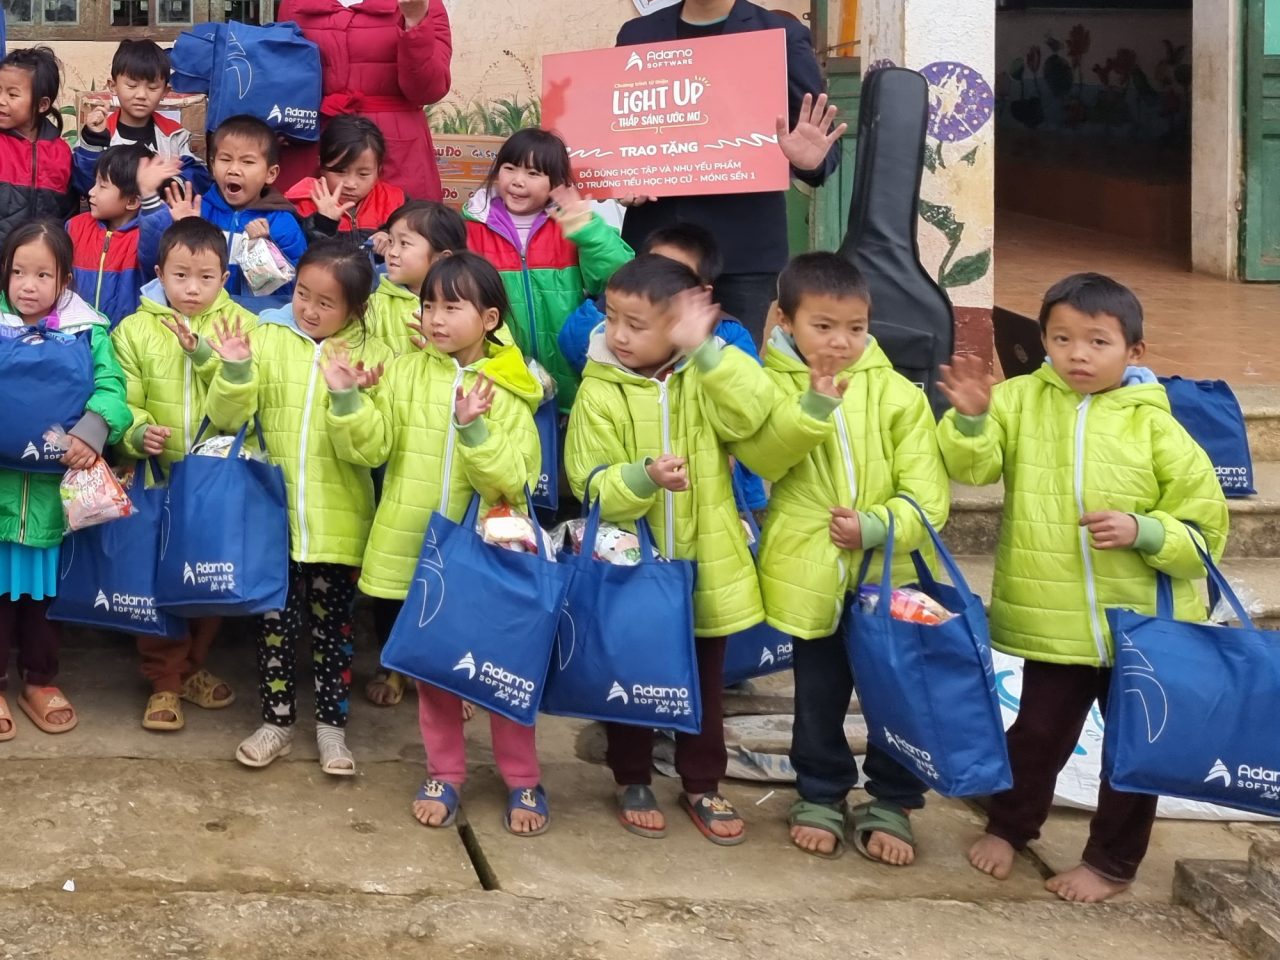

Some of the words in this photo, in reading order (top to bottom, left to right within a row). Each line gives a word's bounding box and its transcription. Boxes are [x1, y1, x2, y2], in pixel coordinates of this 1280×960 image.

[646, 48, 693, 61] Adamo
[647, 58, 693, 68] SOFTWARE
[673, 78, 704, 106] UP
[284, 106, 318, 118] Adamo
[620, 144, 657, 158] TRAO
[660, 140, 698, 157] TẶNG
[620, 168, 638, 176] HỌC
[750, 172, 755, 180] 1
[1214, 466, 1247, 475] damo
[196, 562, 234, 574] Adamo
[197, 574, 234, 584] SOFTWARE
[113, 606, 157, 616] SOFTWARE
[482, 662, 535, 692] Adamo
[478, 674, 531, 700] SOFTWARE
[632, 684, 688, 698] Adamo
[634, 697, 689, 708] SOFTWARE
[1236, 780, 1280, 792] SOFTW
